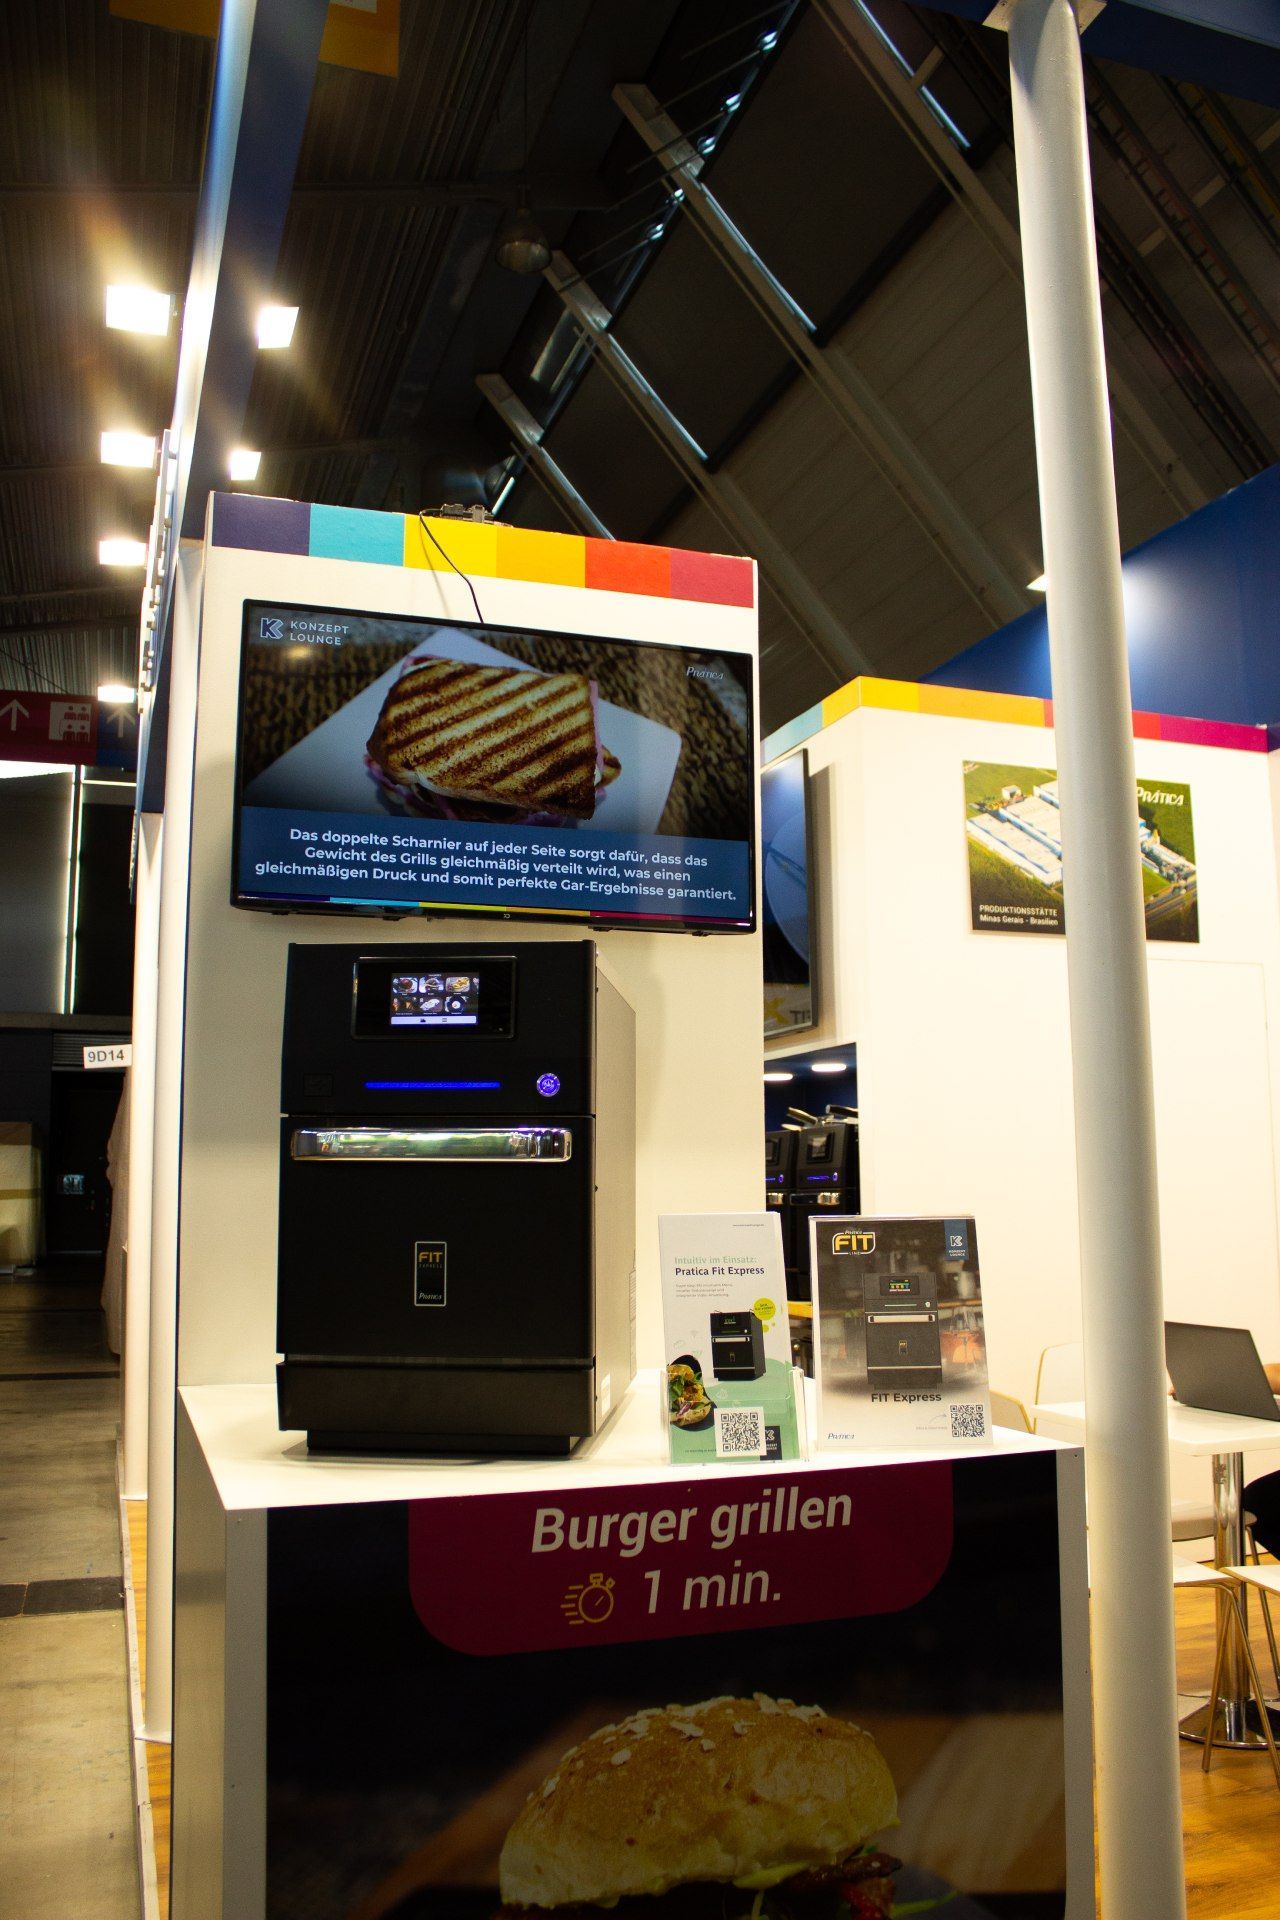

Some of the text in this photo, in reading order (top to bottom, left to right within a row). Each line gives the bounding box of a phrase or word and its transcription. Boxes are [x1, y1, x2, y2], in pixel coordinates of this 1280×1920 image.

[290, 620, 350, 634] KONZEPT
[290, 633, 342, 646] LOUNGE
[290, 828, 708, 867] Das doppelte Scharnier auf jeder Seite sorgt dafür, dass das
[304, 846, 691, 882] Gewicht des Grills gleichmäßig verteilt wird, was einen
[255, 861, 737, 901] gleichmäßigen Druck und somit perfekte Gar-Ergebnisse garantiert.
[979, 904, 1058, 917] PRODUKTIONSSTÄTTE
[980, 914, 1001, 923] Minas
[1002, 915, 1024, 924] Gerais
[1030, 916, 1059, 926] Brasilien
[88, 1049, 125, 1063] 9D14
[835, 1234, 873, 1251] FIT
[418, 1251, 443, 1263] FIT
[674, 1255, 757, 1265] Intuitiv im Einsatz:
[675, 1266, 765, 1277] Pratica Fit Express
[871, 1392, 942, 1404] FIT Express
[531, 1486, 853, 1557] Burger grillen
[643, 1559, 782, 1614] 1 min.
